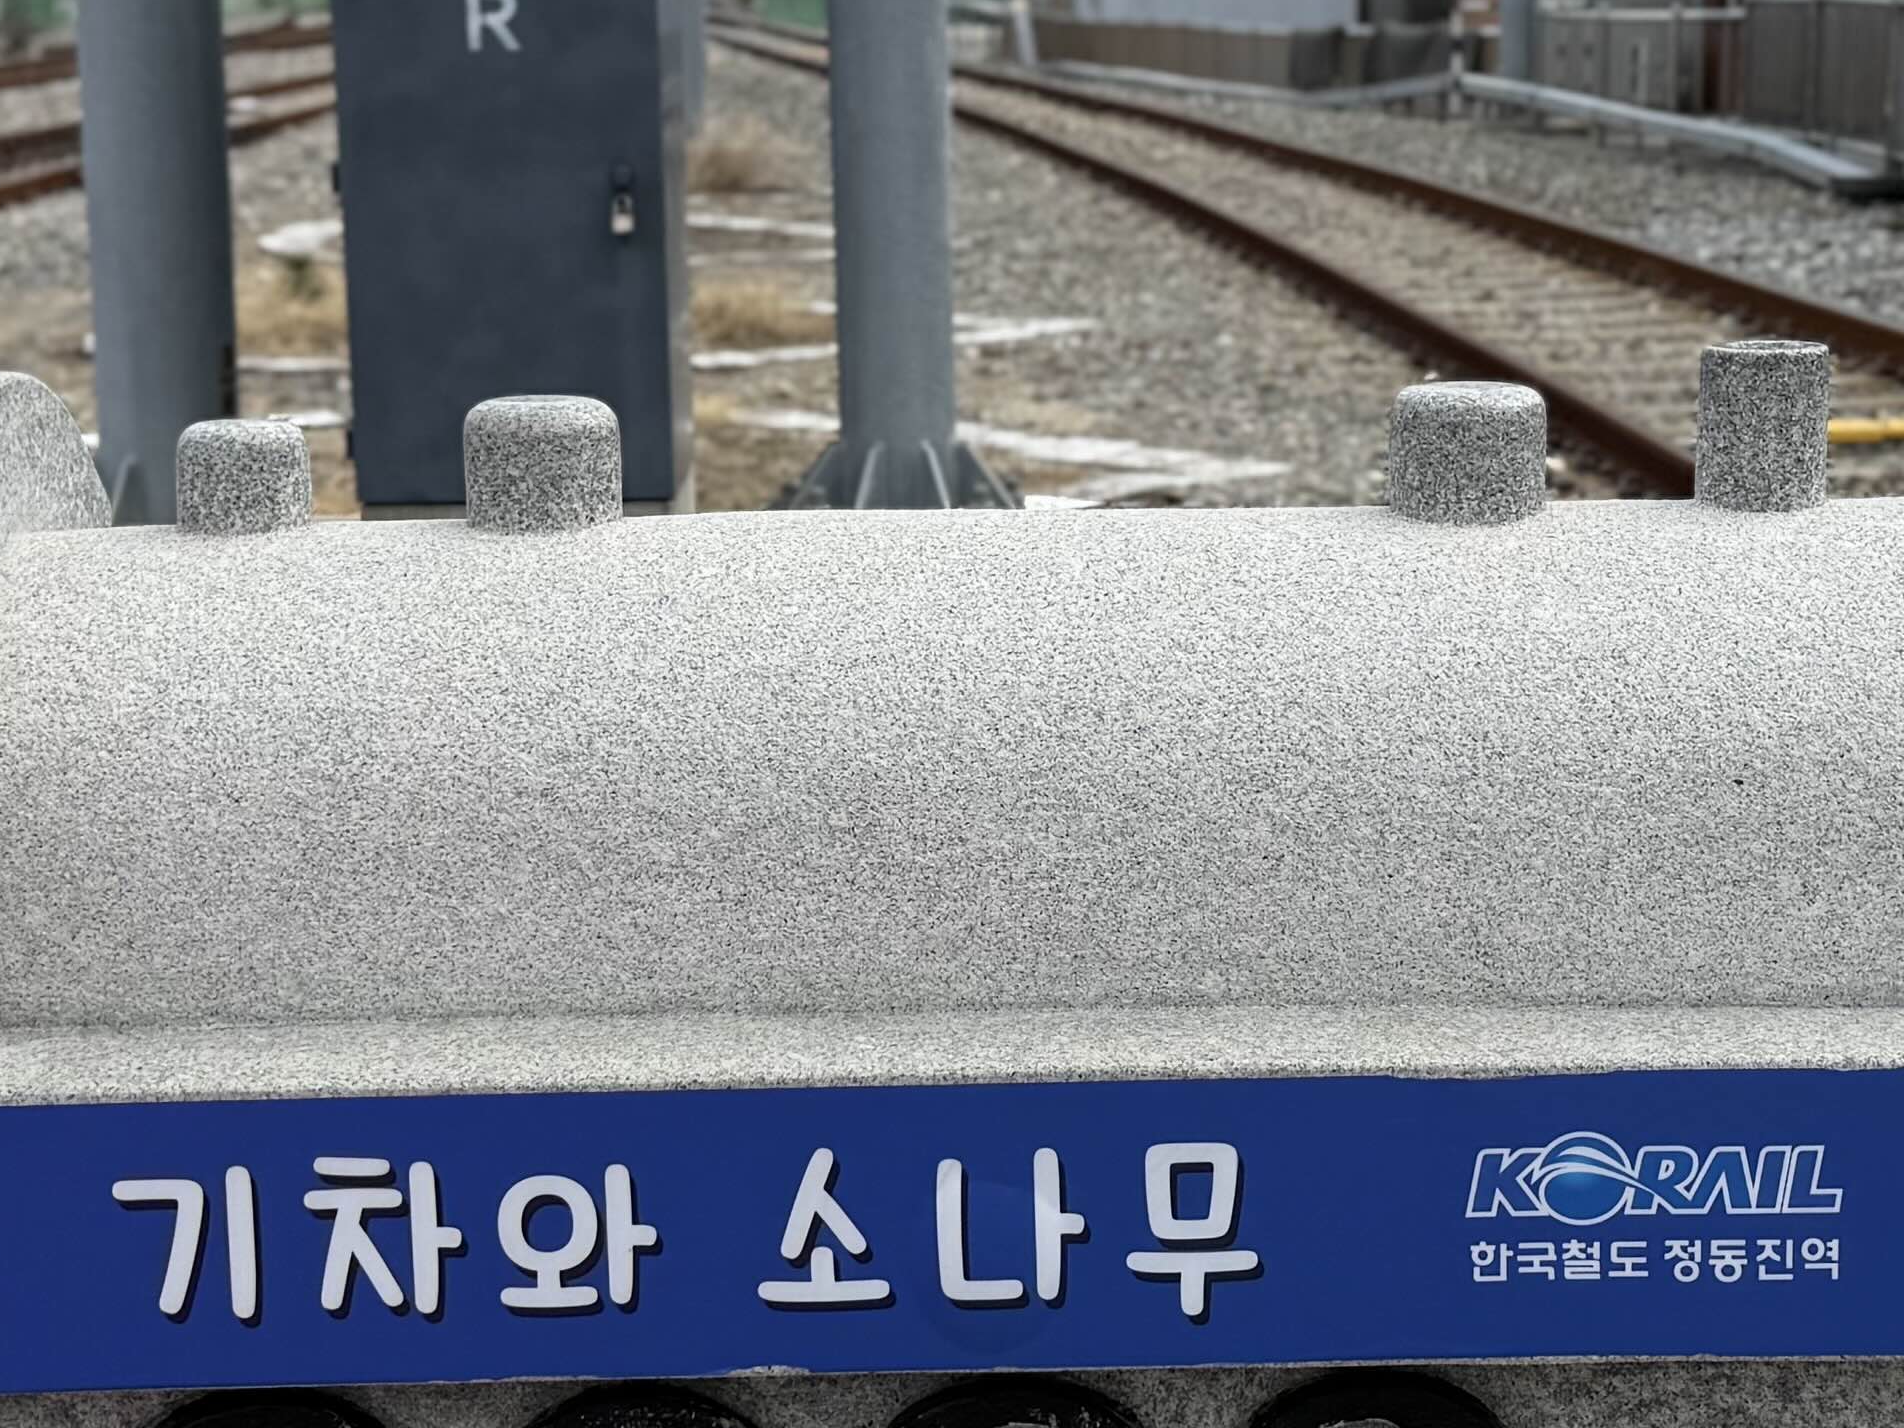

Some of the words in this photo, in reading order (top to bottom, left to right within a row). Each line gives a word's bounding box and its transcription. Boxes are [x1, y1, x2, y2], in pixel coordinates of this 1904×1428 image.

[1465, 1131, 1843, 1225] KORAIL
[112, 1157, 659, 1322] 기차와
[757, 1142, 1260, 1318] 소나무
[1470, 1239, 1649, 1283] 한국철도
[1664, 1237, 1840, 1283] 정동진역
